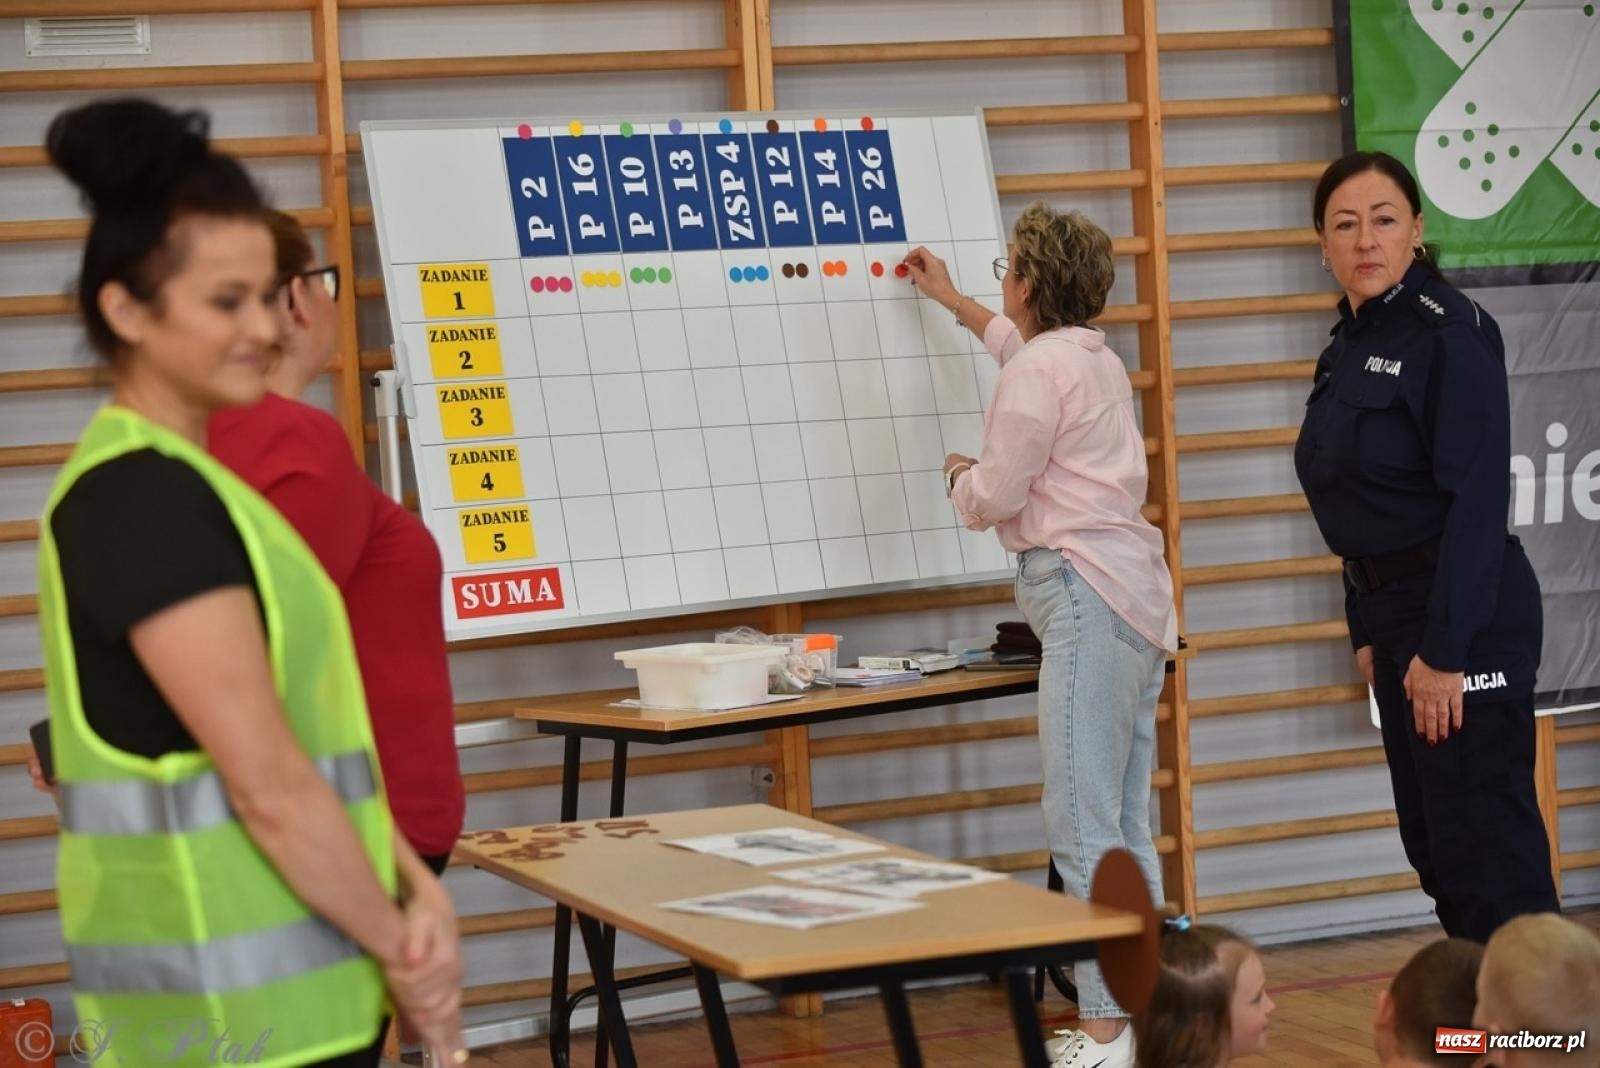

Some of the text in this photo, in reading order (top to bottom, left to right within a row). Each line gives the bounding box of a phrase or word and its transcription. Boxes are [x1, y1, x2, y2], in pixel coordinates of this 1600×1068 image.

[669, 149, 704, 229] P 13
[765, 146, 799, 225] P 12
[814, 148, 846, 225] P 14
[857, 147, 894, 230] P 26
[568, 153, 606, 239] P 16
[619, 157, 655, 237] P 10
[520, 176, 556, 241] P 2
[420, 269, 488, 283] ZADANIE
[453, 291, 465, 311] 1
[429, 328, 496, 343] ZADANIE
[459, 350, 473, 370] 2
[1364, 355, 1402, 377] POLICJA
[440, 387, 505, 403] ZADANIE
[470, 407, 484, 427] 3
[449, 449, 516, 465] ZADANIE
[480, 472, 494, 491] 4
[462, 510, 528, 527] ZADANIE
[493, 533, 507, 552] 5
[460, 577, 557, 610] SUMA
